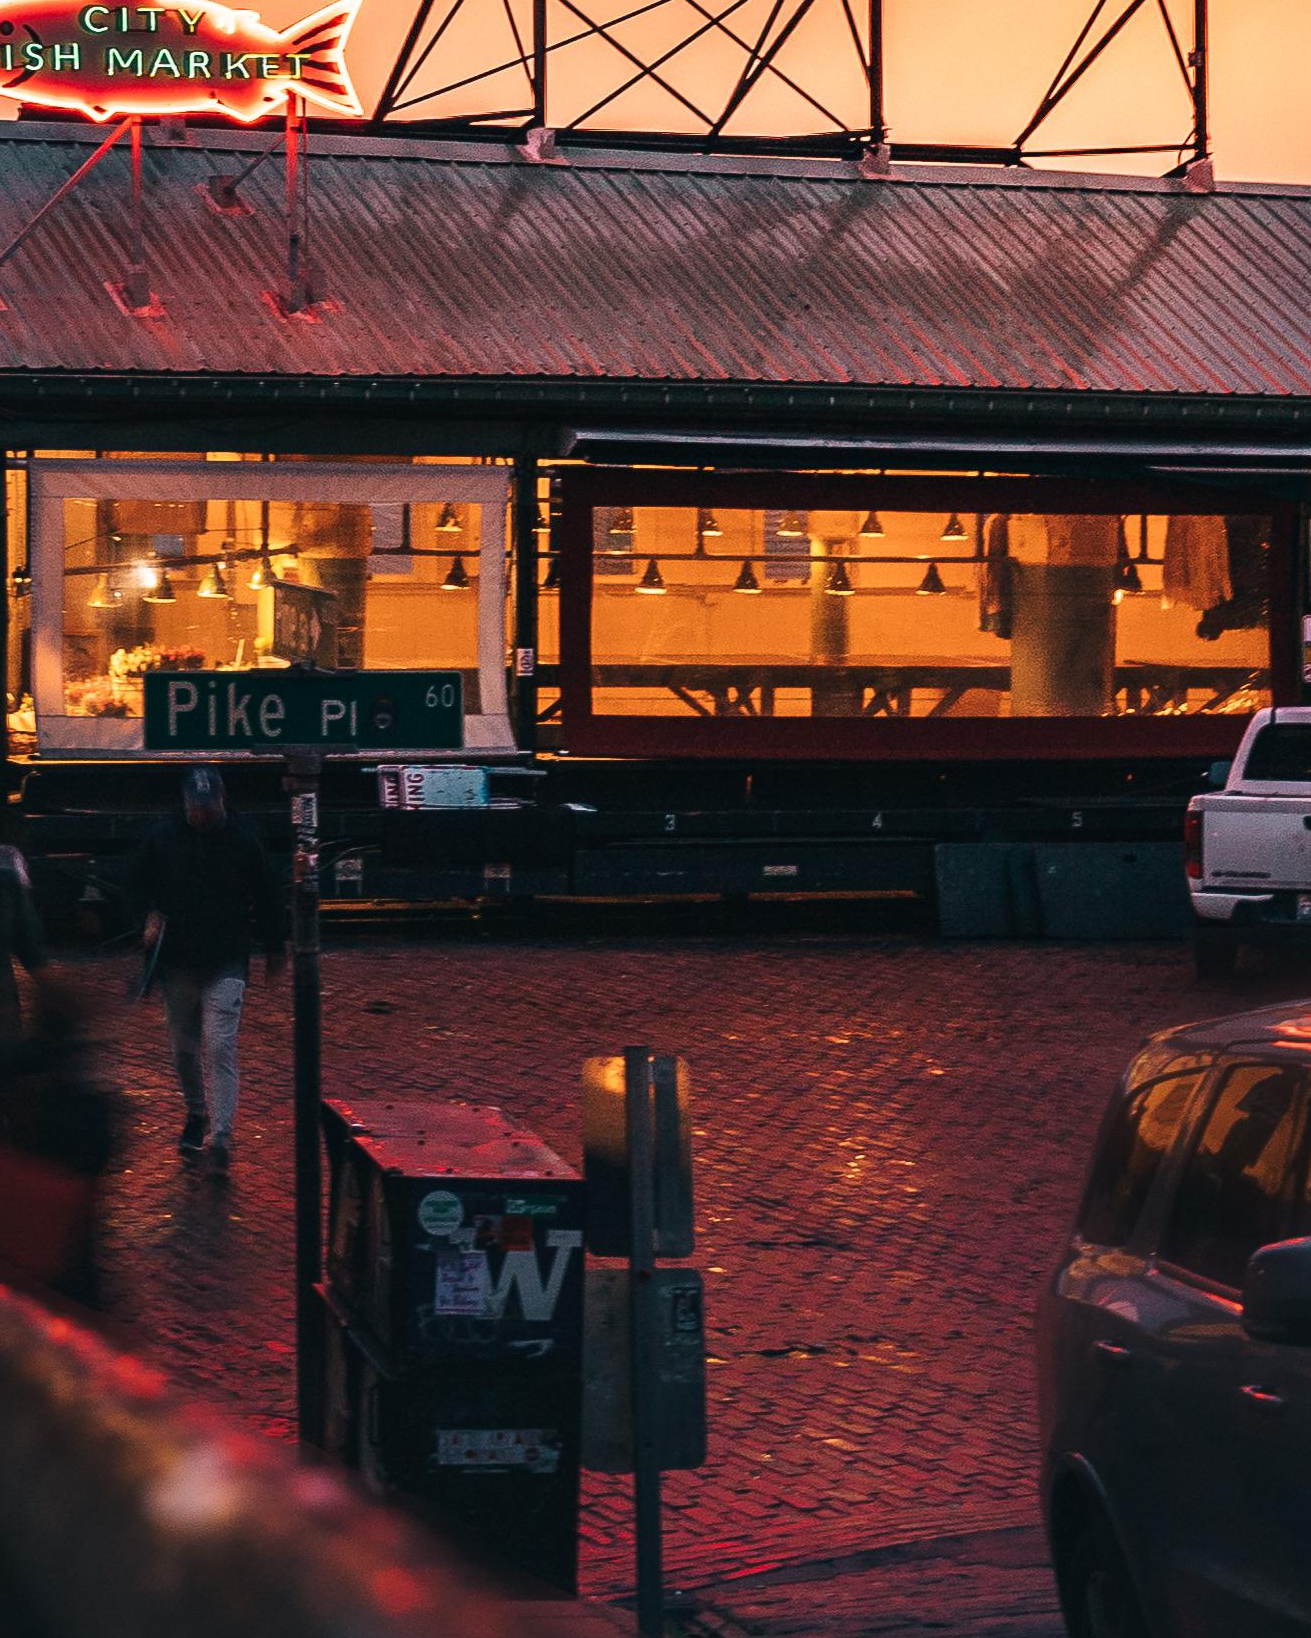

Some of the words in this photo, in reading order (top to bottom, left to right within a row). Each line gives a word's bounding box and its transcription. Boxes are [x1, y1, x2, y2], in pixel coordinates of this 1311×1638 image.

[82, 5, 206, 34] CITY
[106, 47, 311, 80] MARKET
[167, 680, 286, 738] Pike
[320, 699, 358, 737] Pl
[425, 684, 455, 708] 60
[664, 813, 676, 831] 3
[870, 810, 882, 829] 4
[1071, 810, 1083, 827] 5
[450, 1228, 585, 1322] W
